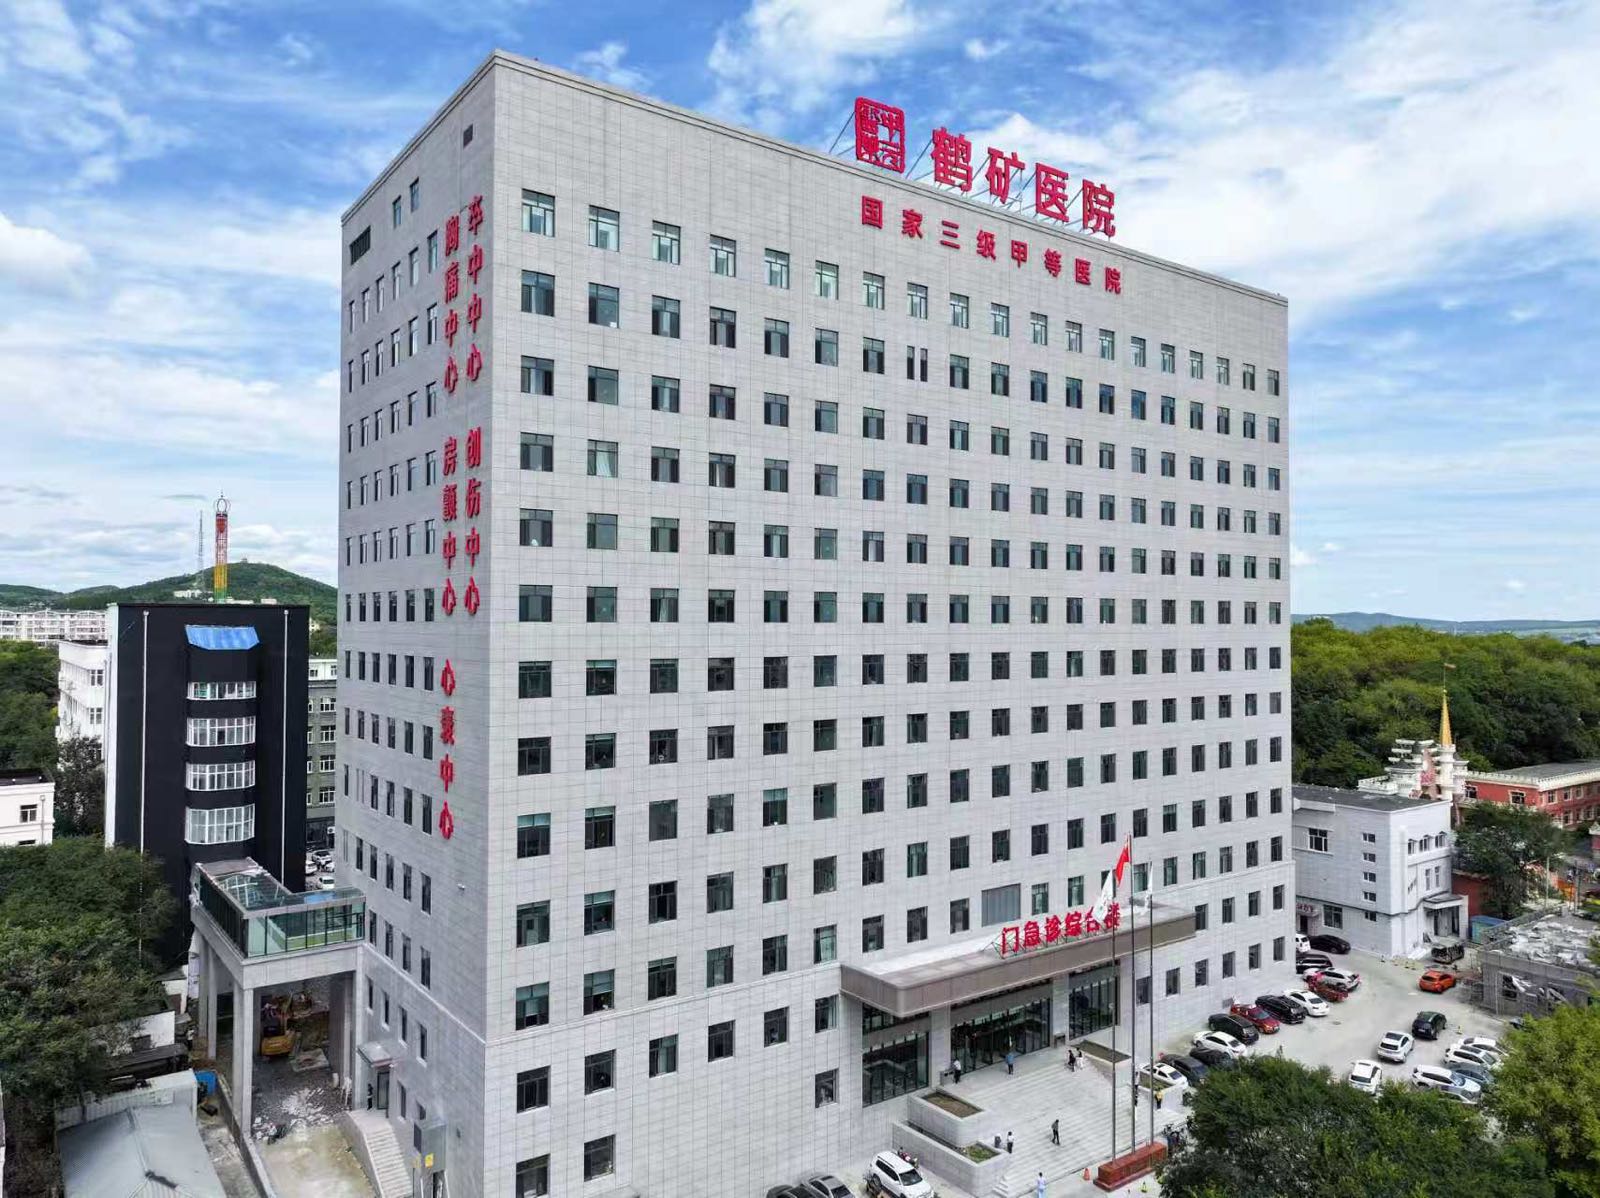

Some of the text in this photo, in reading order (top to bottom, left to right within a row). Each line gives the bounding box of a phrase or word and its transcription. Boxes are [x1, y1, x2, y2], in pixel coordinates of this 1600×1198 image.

[861, 194, 1122, 294] 国家三级甲等医院
[931, 127, 1116, 237] 鹤矿医院
[466, 195, 484, 380] 卒中中心
[442, 437, 458, 614] 房颤中心
[464, 427, 482, 614] 创伤中心
[439, 659, 456, 839] 心衰中心
